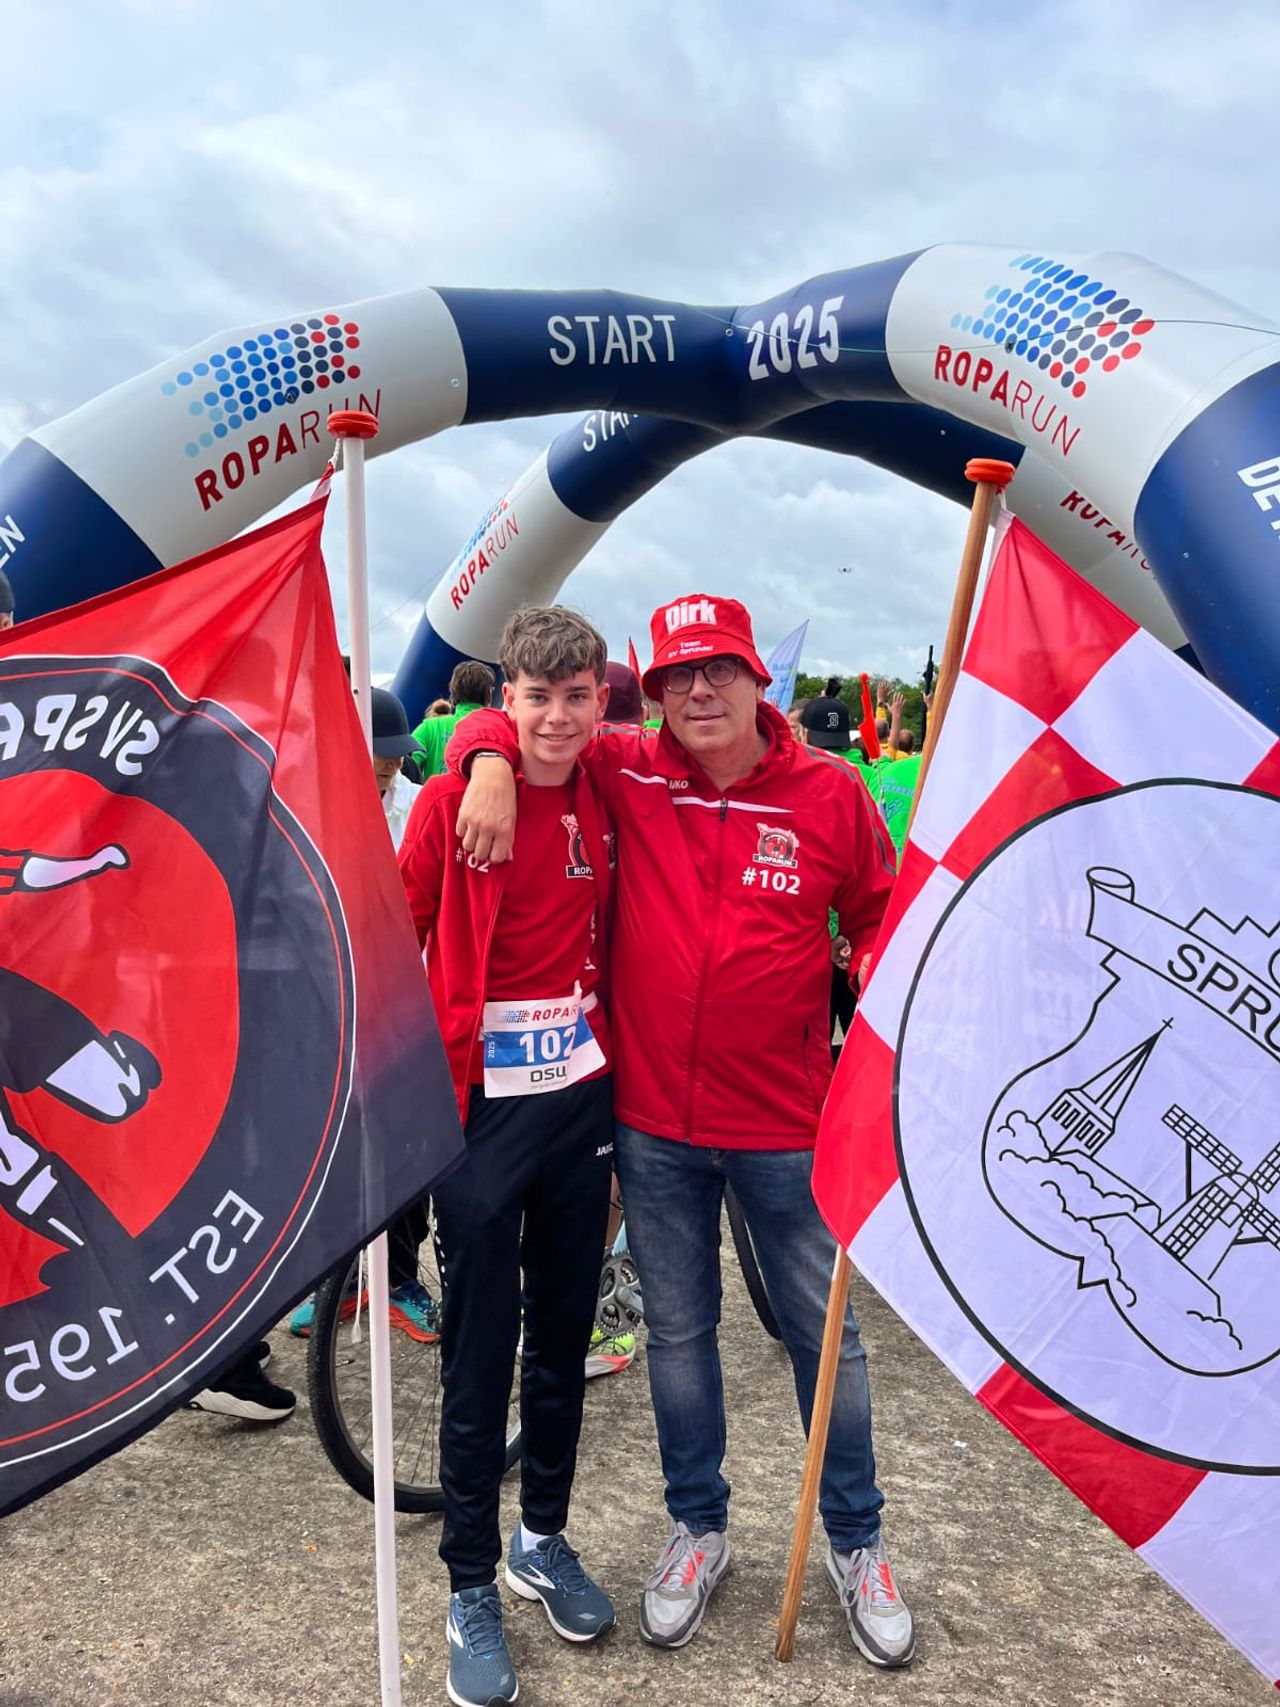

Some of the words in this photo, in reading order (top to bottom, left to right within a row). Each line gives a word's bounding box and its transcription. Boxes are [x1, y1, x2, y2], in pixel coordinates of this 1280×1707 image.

[547, 314, 676, 367] START
[746, 295, 845, 382] 2025
[934, 344, 1081, 458] ROPARUN
[194, 388, 381, 512] ROPARN
[450, 512, 520, 611] ROPARUN
[665, 599, 717, 636] Dirk
[742, 866, 801, 895] #102
[519, 1025, 577, 1064] 102
